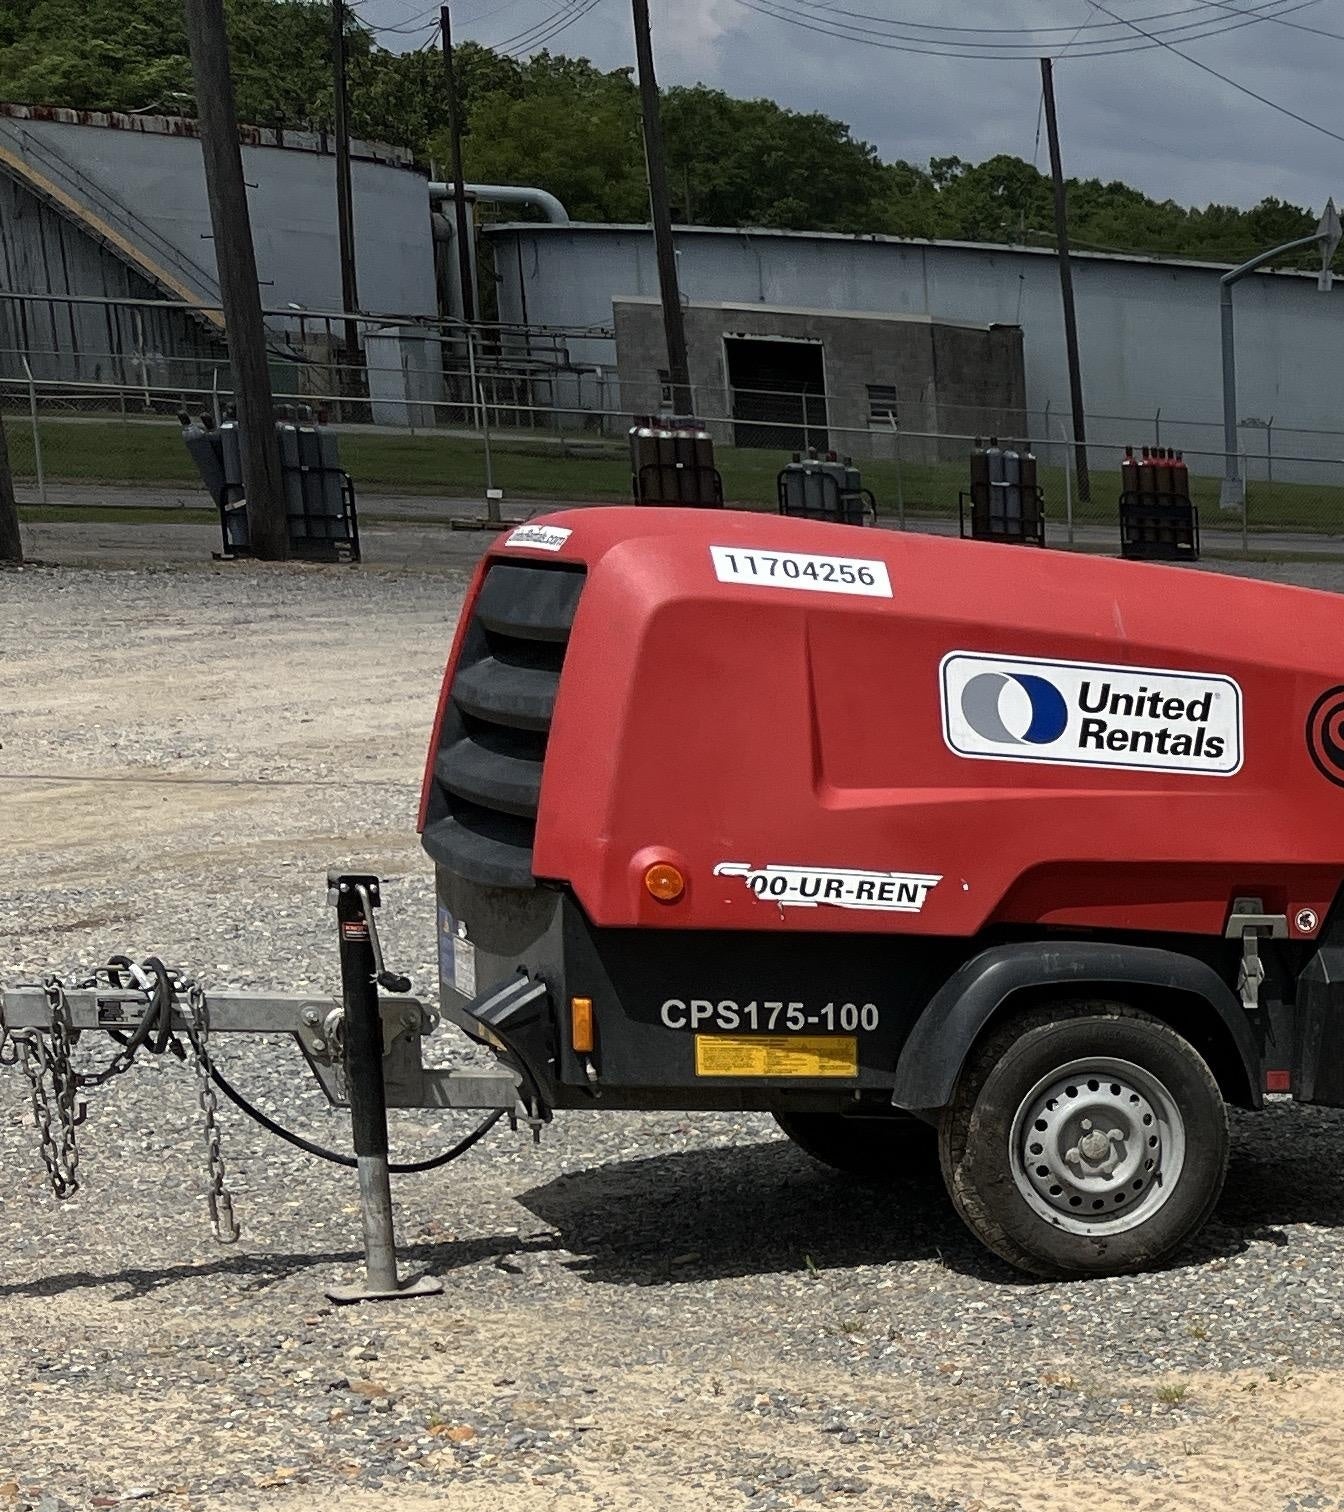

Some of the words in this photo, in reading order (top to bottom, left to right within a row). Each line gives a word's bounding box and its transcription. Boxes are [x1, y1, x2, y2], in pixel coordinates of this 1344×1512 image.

[725, 554, 875, 586] 11704256
[1077, 680, 1214, 723] United
[1078, 717, 1225, 759] Rentals
[660, 998, 880, 1032] CPS175-100
